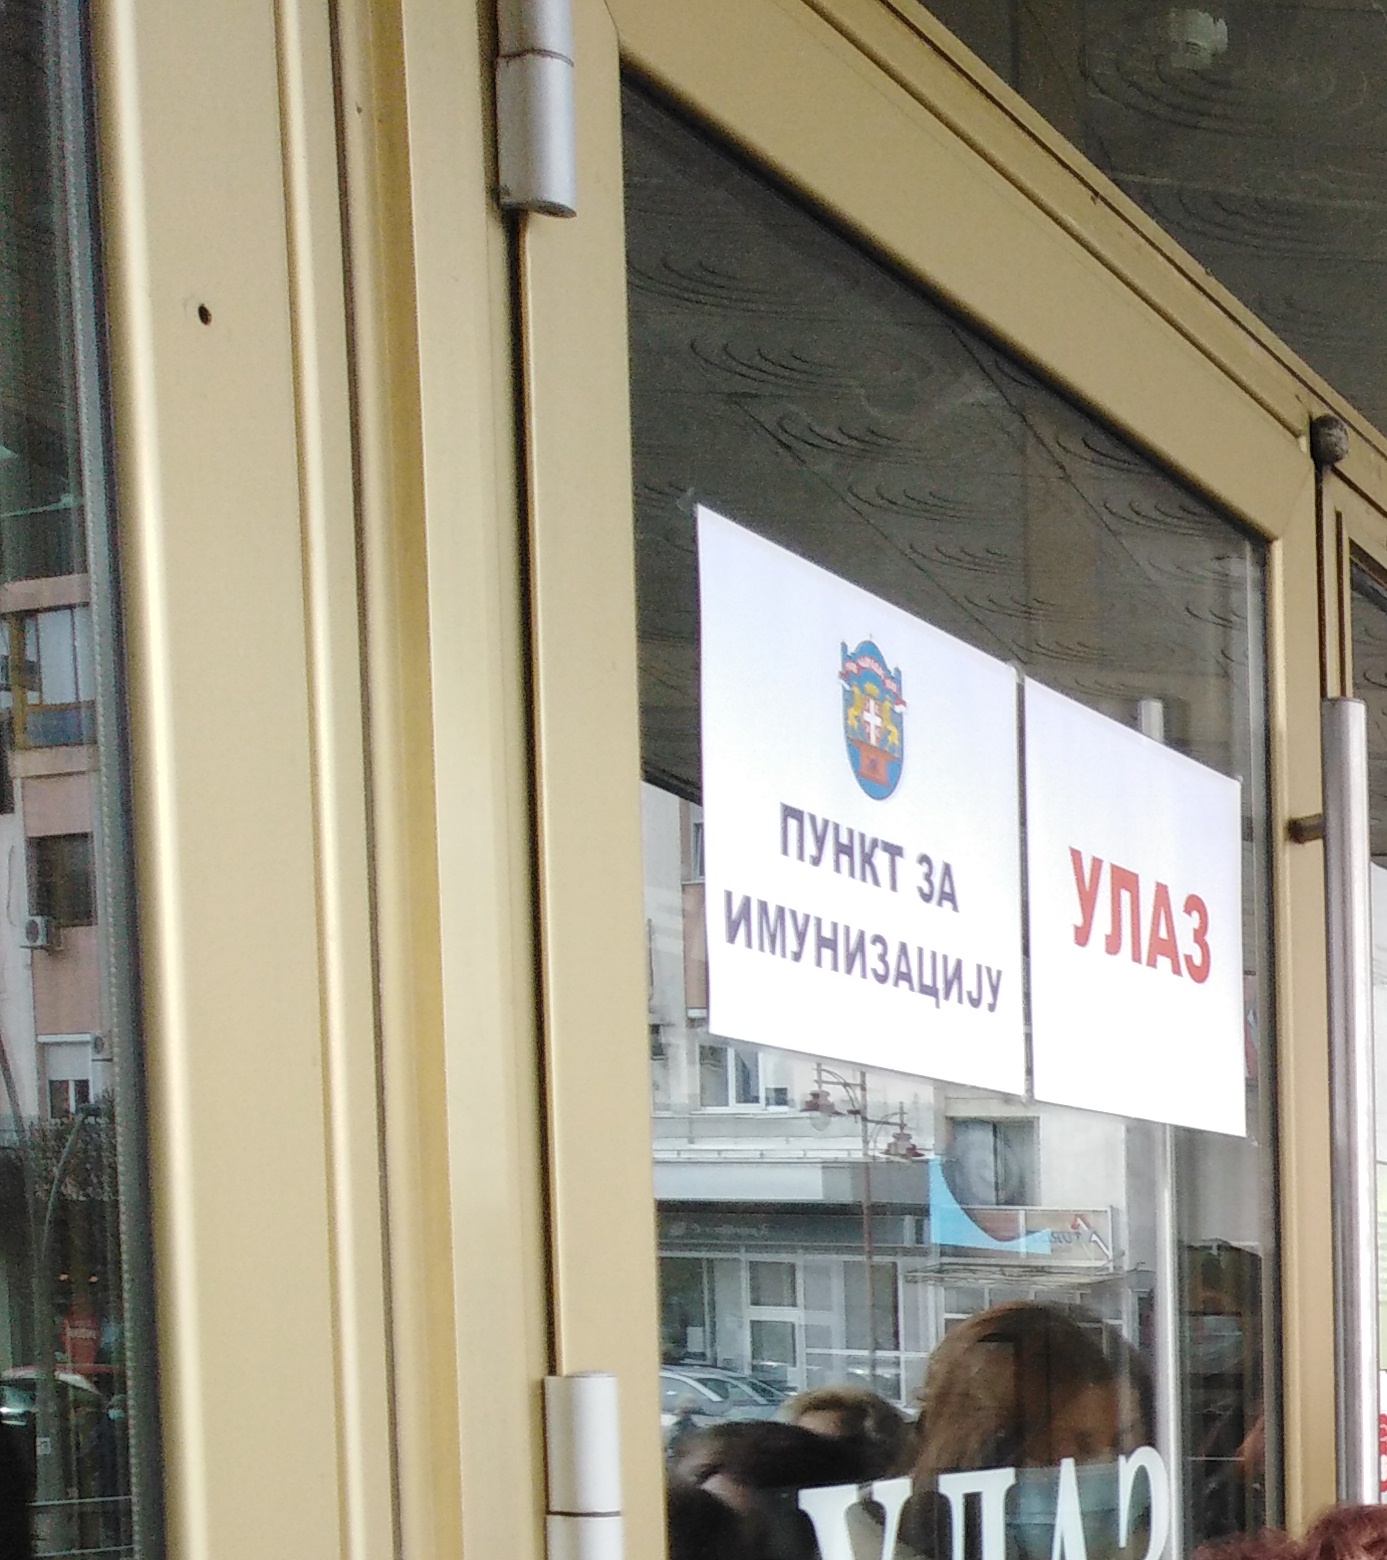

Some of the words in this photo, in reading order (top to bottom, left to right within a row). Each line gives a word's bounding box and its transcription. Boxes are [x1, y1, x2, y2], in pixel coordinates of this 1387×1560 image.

[780, 802, 904, 892] ПУНКТ
[916, 852, 959, 913] ЗА
[1069, 847, 1211, 984] УЛАЗ
[725, 890, 1002, 1013] ИМУНИЗАЦИЈУ
